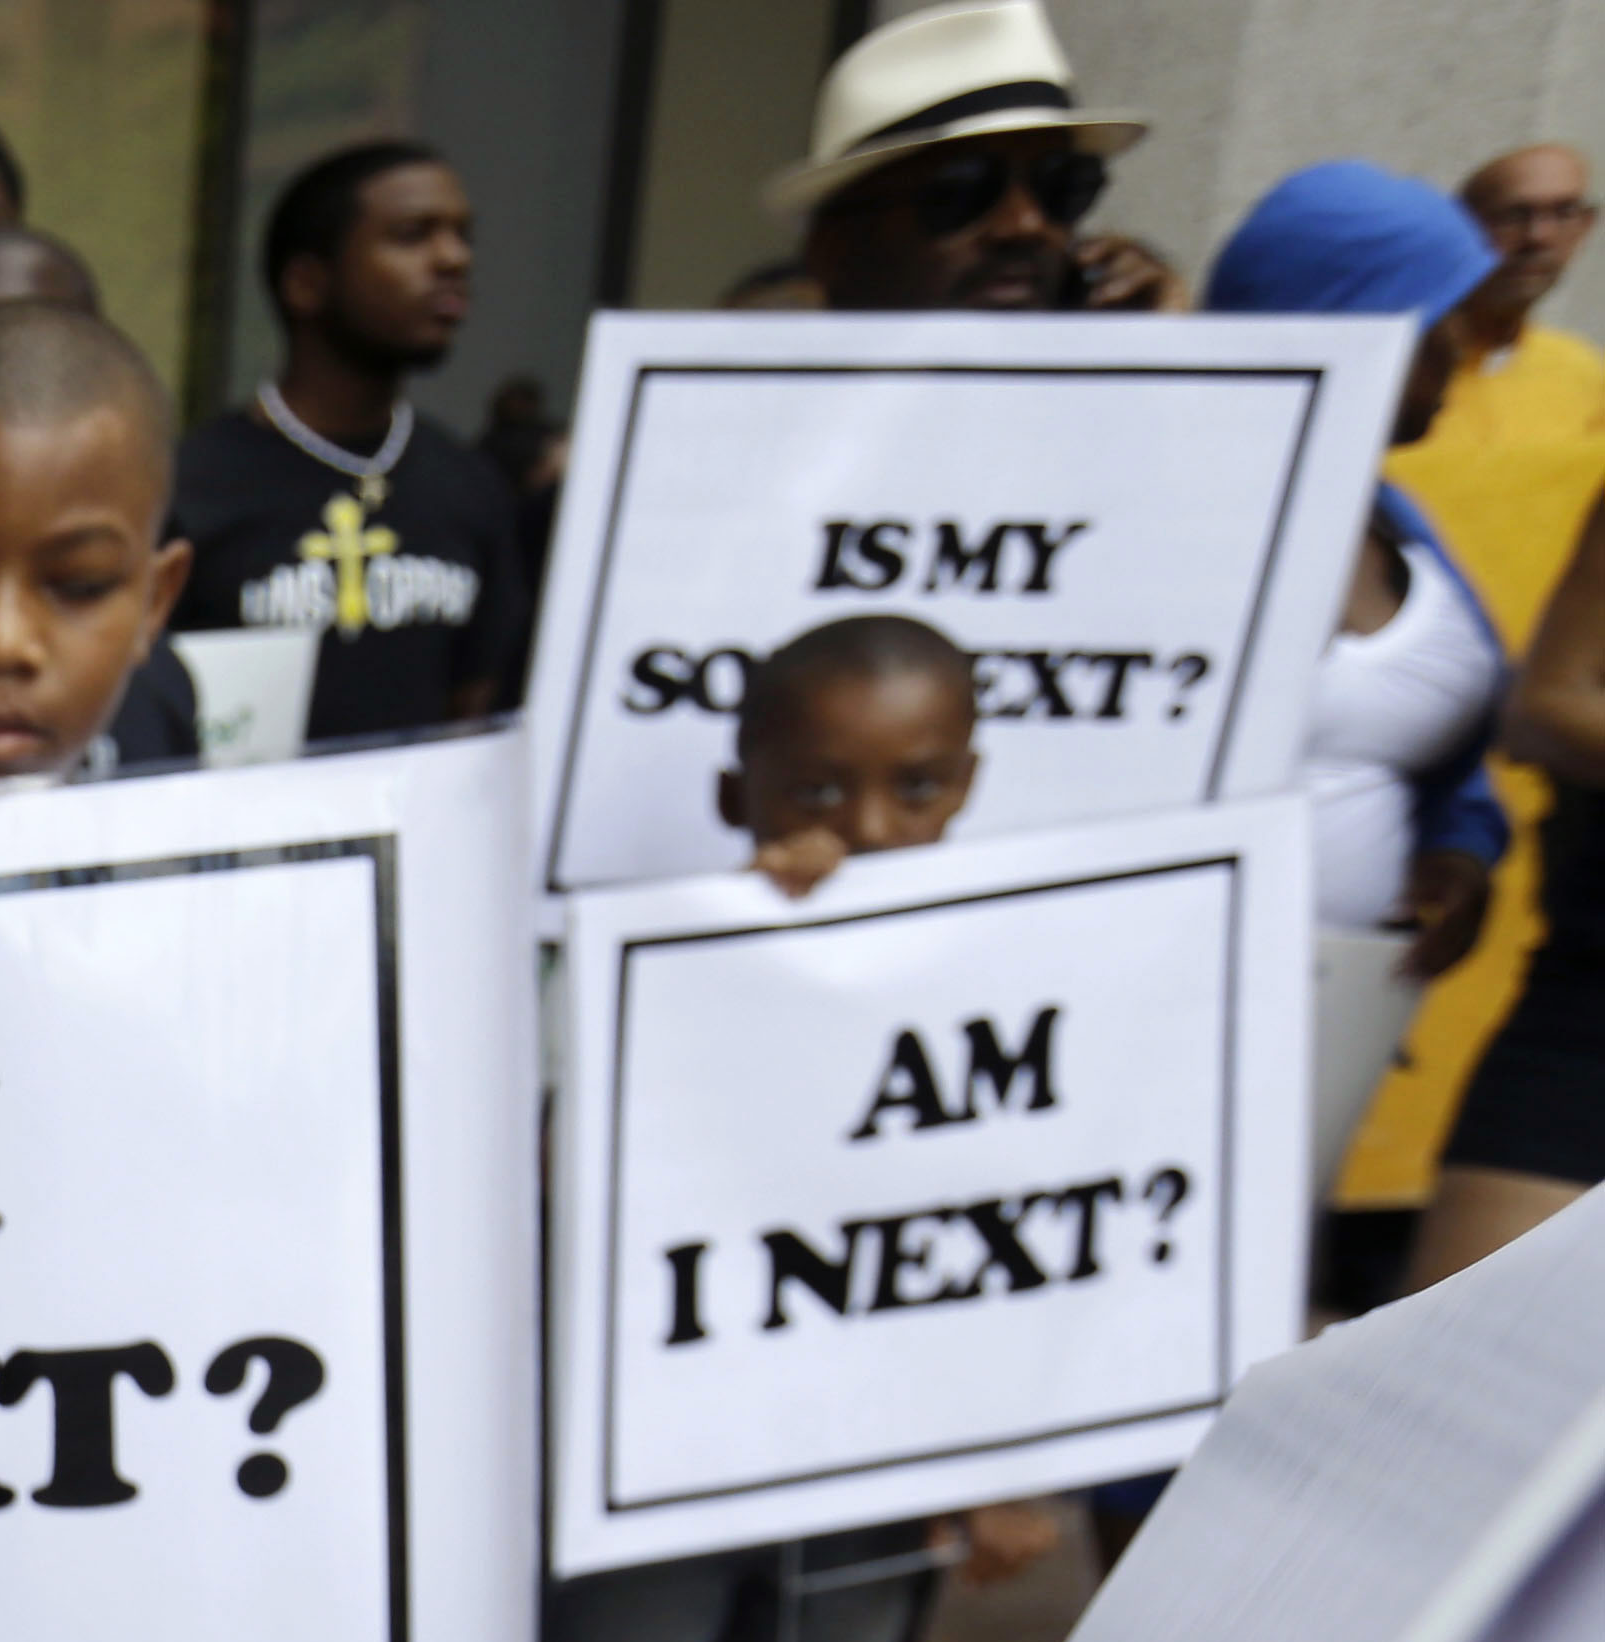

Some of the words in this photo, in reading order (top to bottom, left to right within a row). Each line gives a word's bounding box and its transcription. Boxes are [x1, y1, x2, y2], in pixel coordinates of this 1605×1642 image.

[812, 519, 913, 593] IS
[923, 520, 1090, 596] MY
[620, 648, 750, 714] SO
[964, 652, 1210, 719] EXT?
[848, 1005, 1061, 1143] AM
[663, 1241, 708, 1348] I
[759, 1166, 1193, 1333] NEXT?
